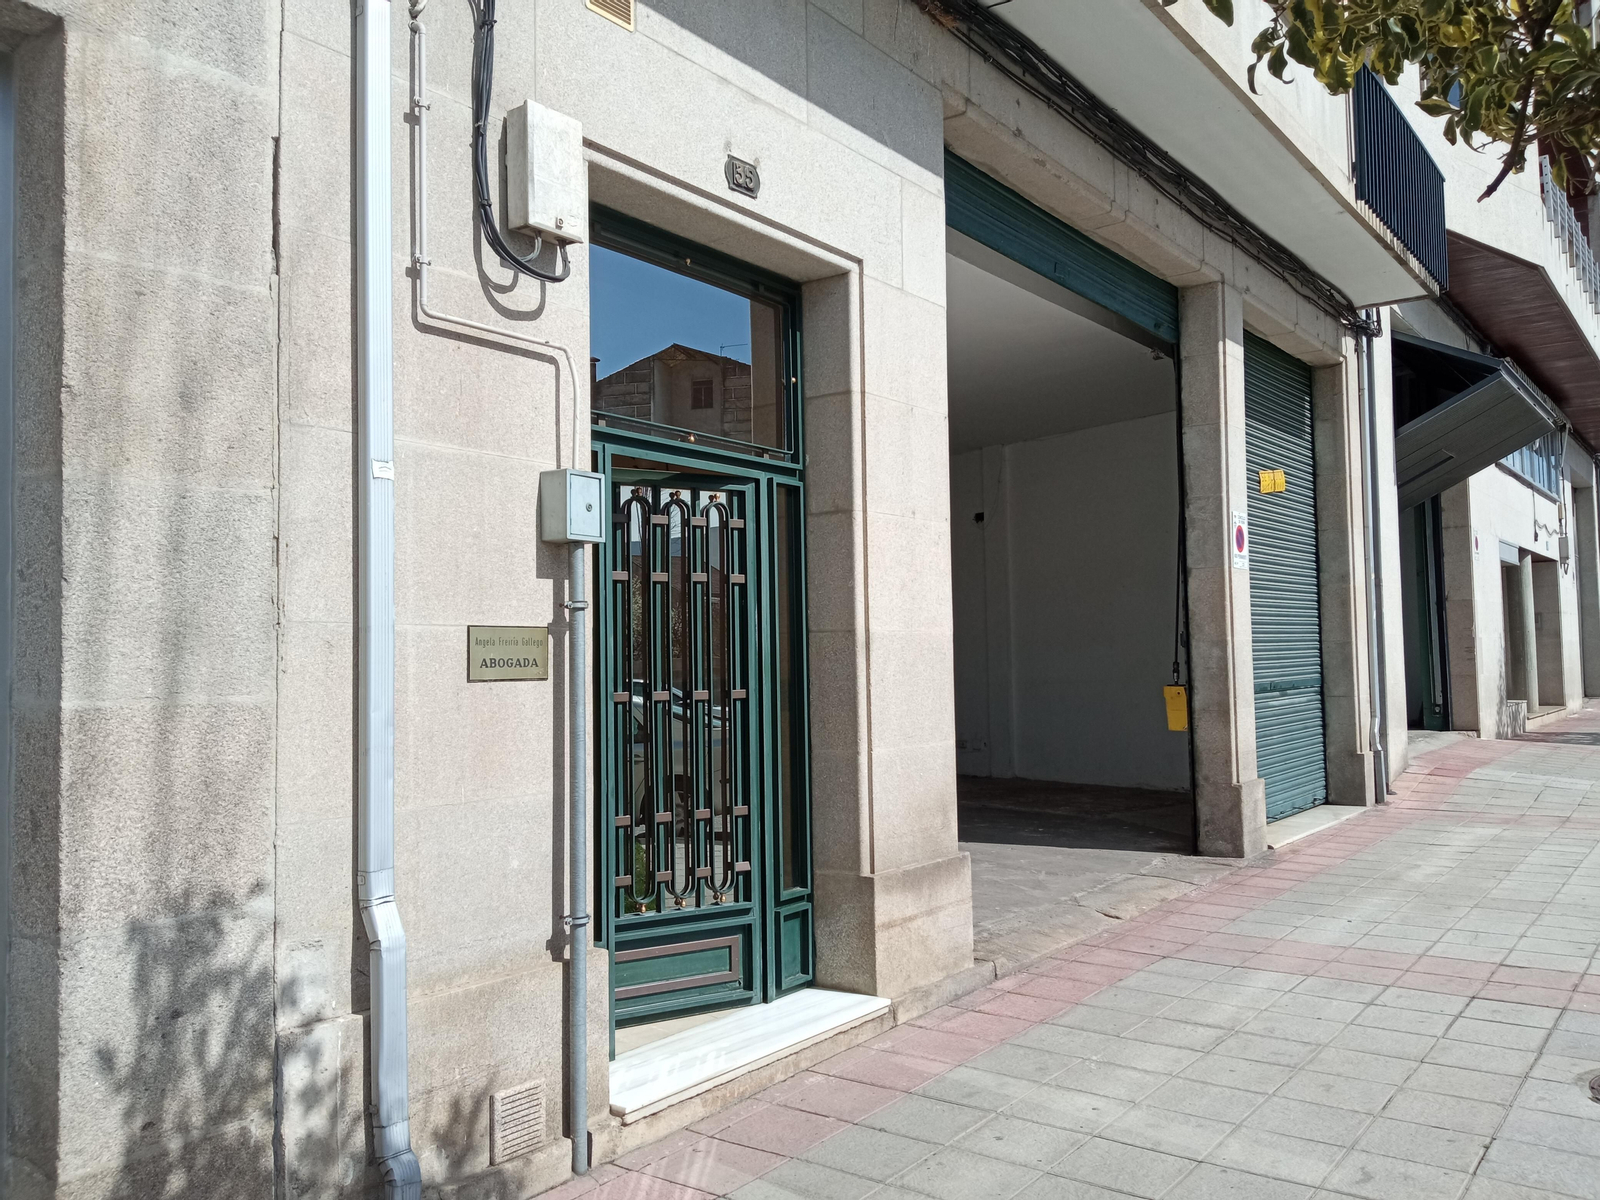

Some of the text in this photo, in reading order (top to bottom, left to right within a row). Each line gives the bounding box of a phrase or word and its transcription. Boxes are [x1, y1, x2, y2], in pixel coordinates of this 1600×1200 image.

[475, 637, 495, 648] Angela
[521, 637, 544, 648] Gallego
[479, 657, 540, 669] ABOGADA
